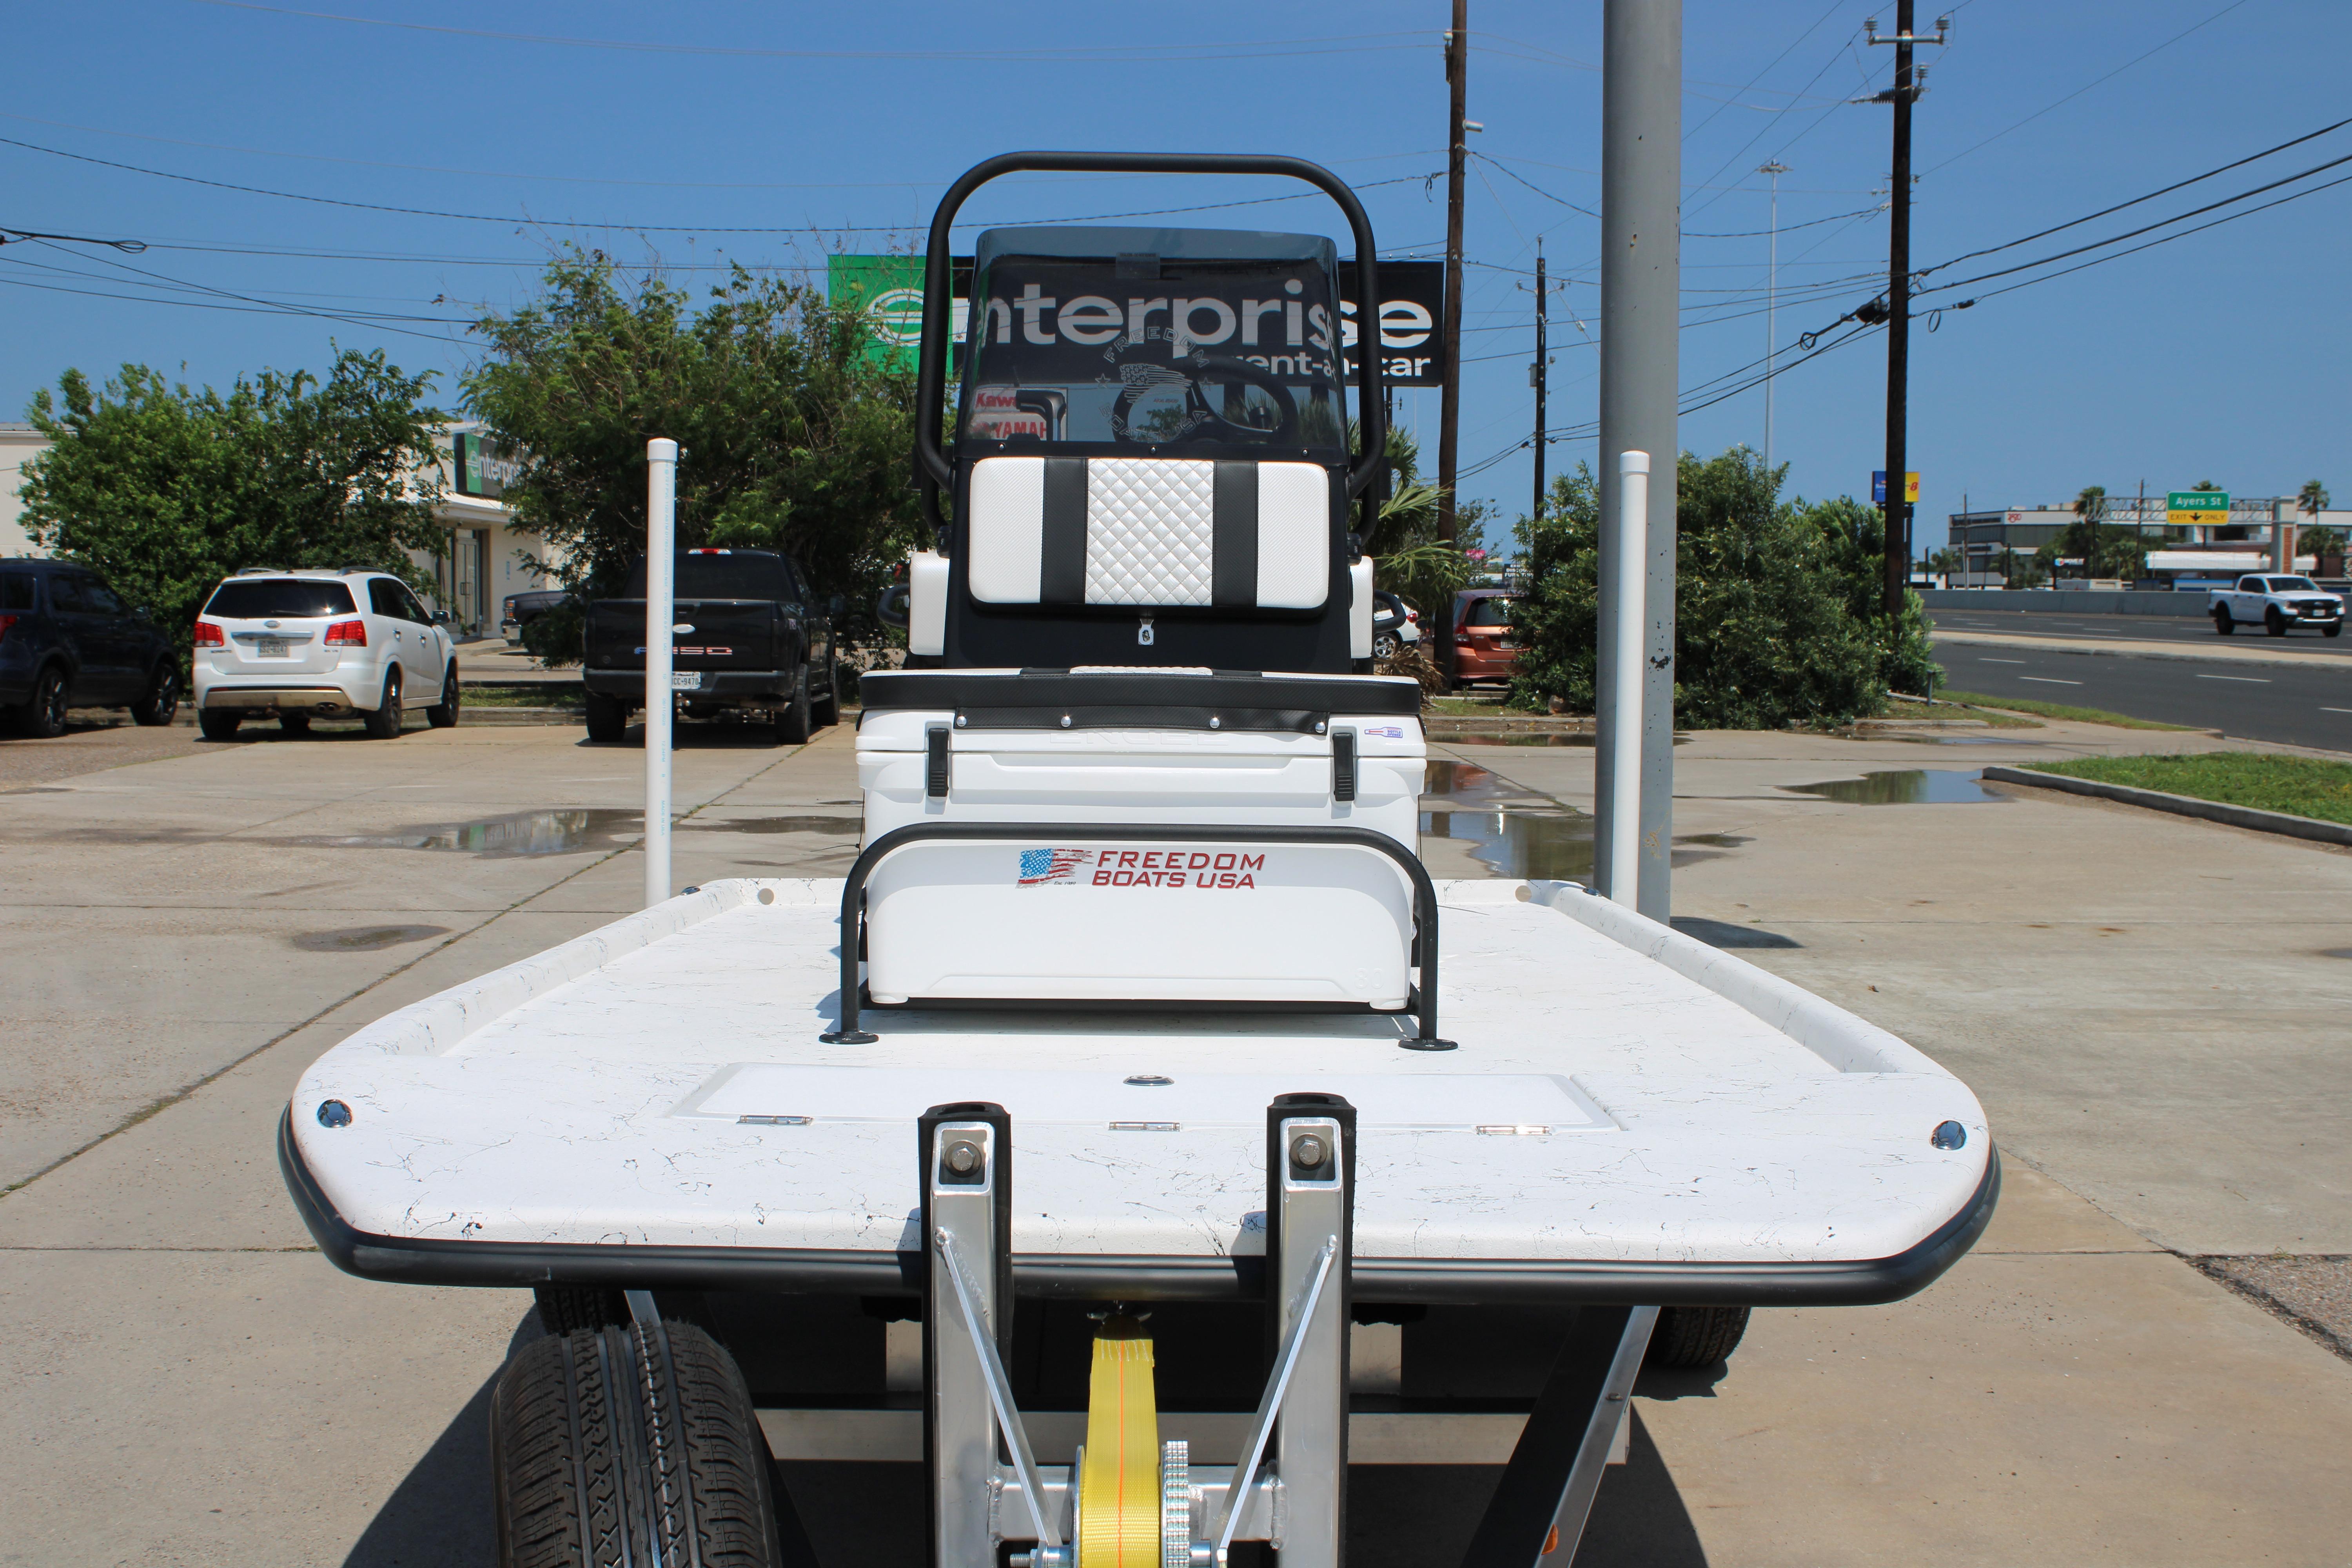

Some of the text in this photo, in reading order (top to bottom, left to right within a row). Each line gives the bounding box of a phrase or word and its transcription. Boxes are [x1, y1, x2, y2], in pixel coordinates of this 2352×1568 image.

[862, 278, 1432, 359] enterprise
[1103, 327, 1210, 368] FREEDOM
[2176, 497, 2222, 508] Ayers St
[1097, 850, 1265, 871] FREEDOM
[1091, 870, 1256, 889] BOATS USA
